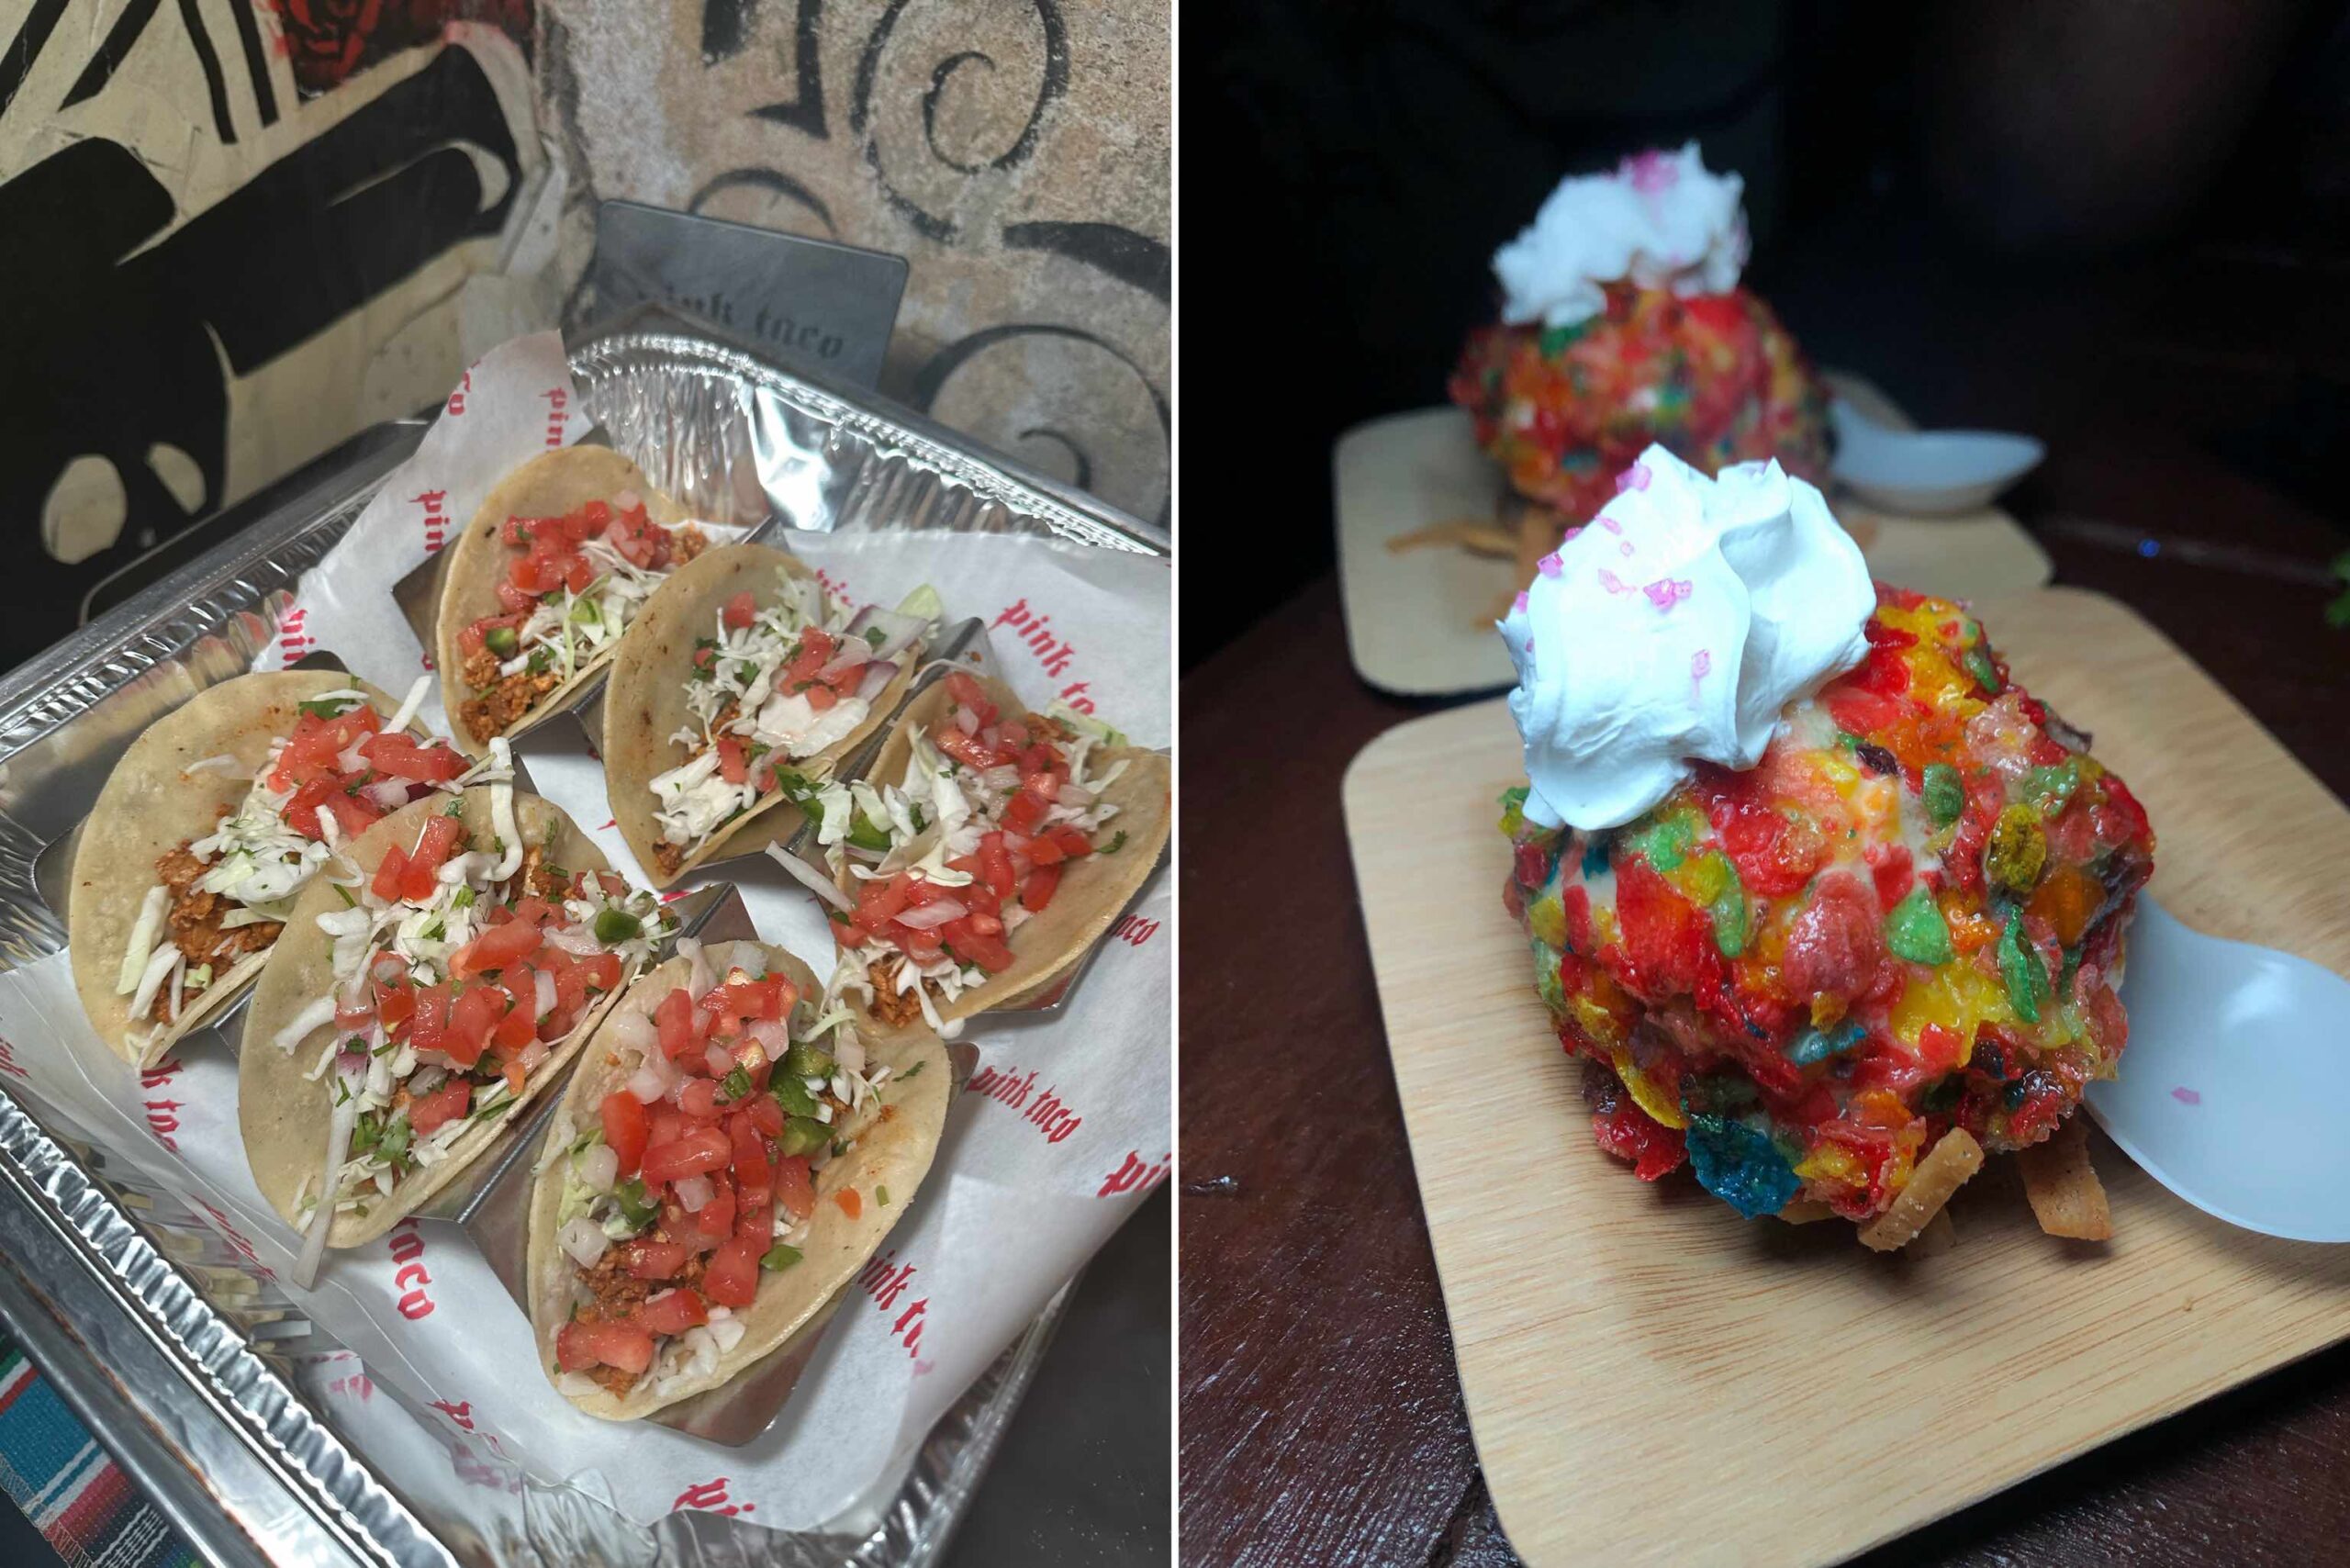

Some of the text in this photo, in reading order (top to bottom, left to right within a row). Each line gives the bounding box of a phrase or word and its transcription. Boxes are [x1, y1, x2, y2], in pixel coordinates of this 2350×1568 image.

[755, 305, 845, 361] taco
[989, 598, 1075, 678] pink
[962, 1065, 1081, 1144] pink taco
